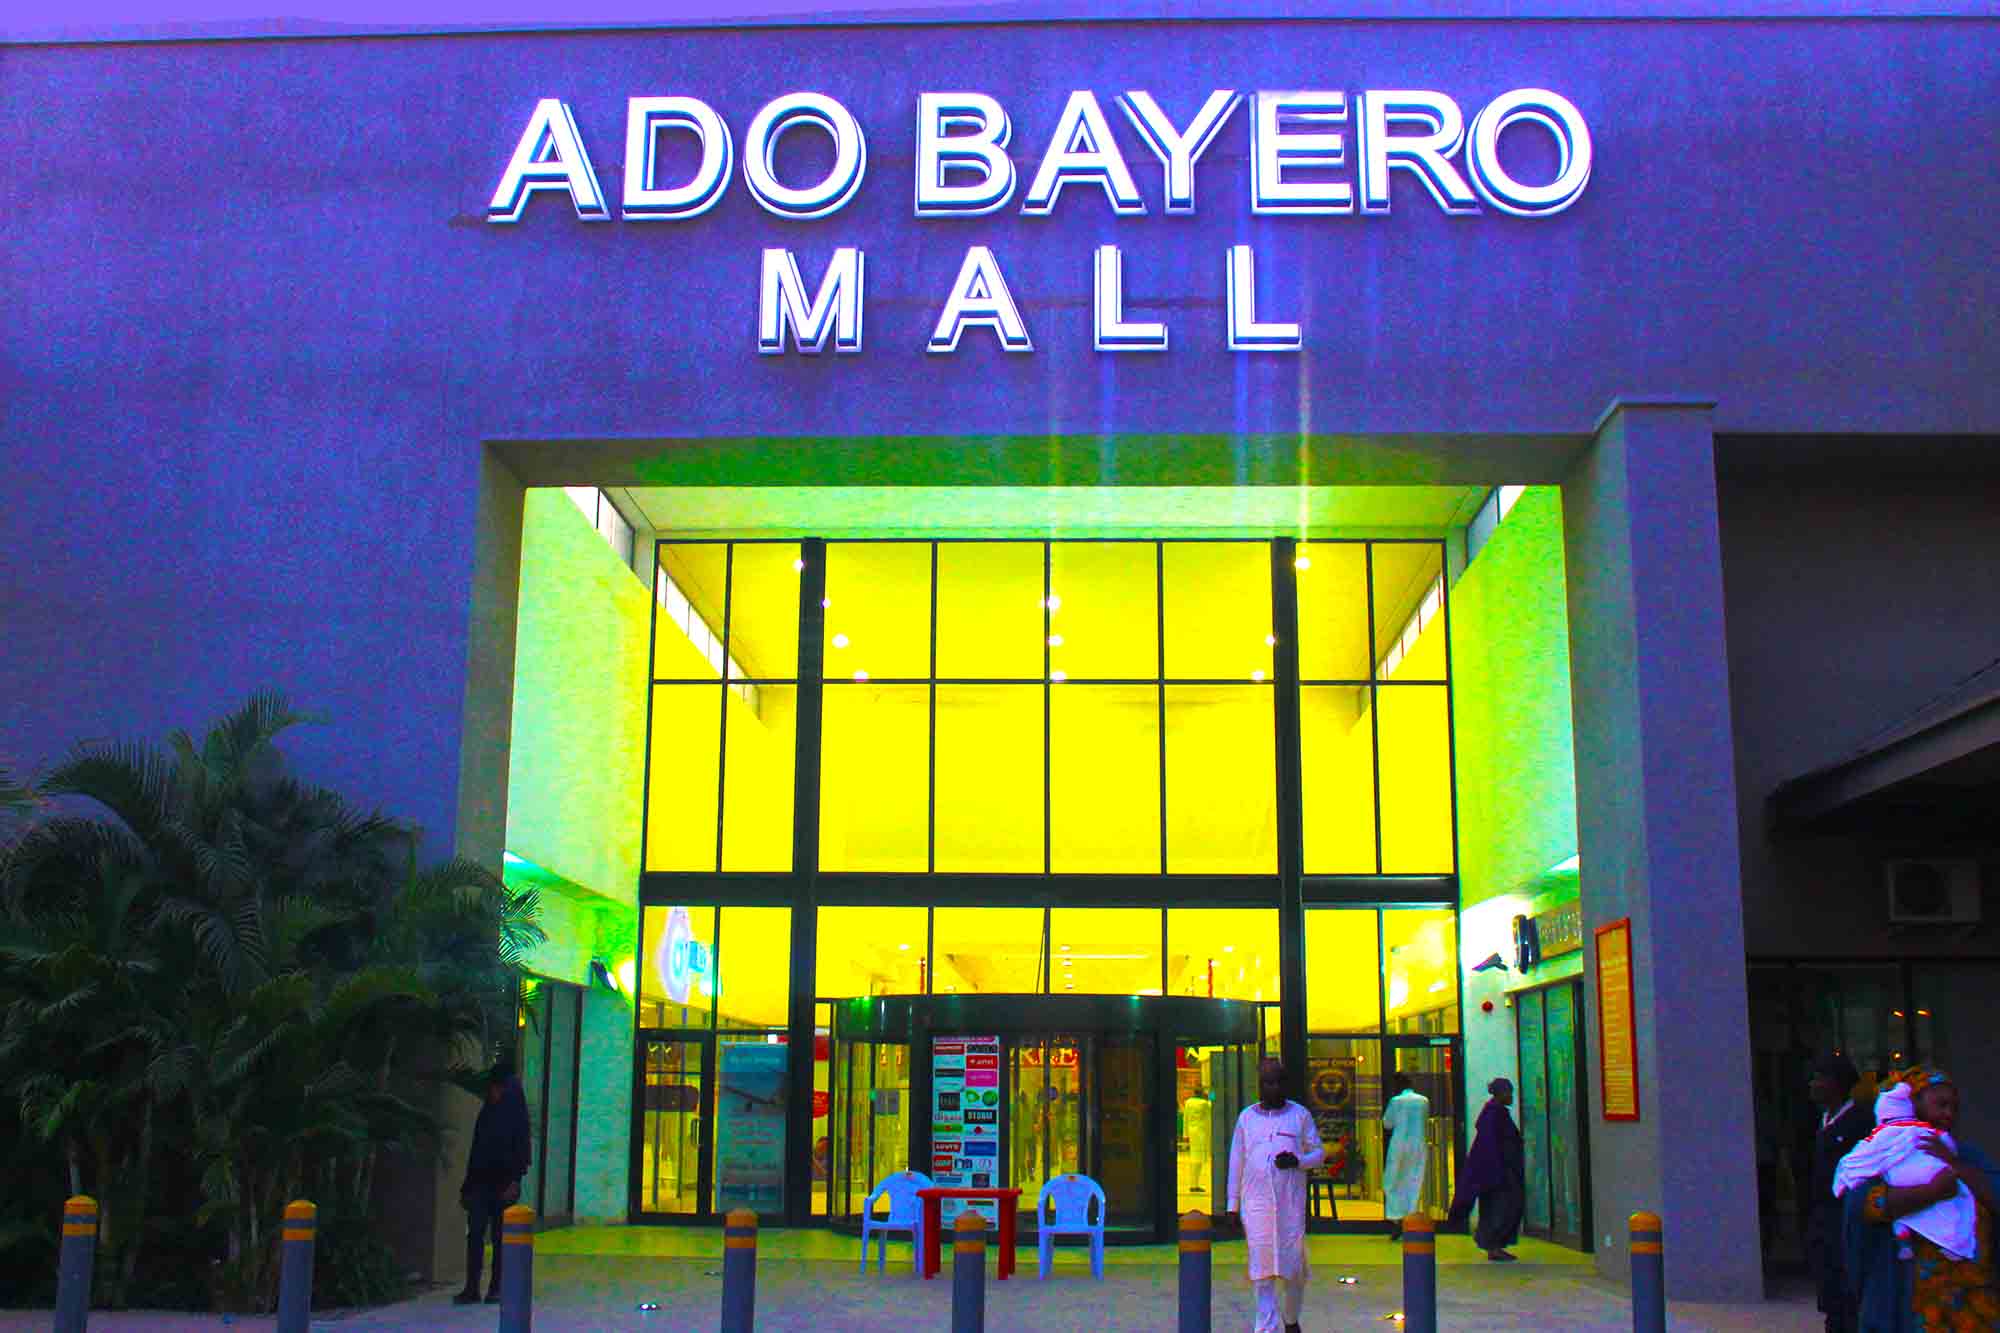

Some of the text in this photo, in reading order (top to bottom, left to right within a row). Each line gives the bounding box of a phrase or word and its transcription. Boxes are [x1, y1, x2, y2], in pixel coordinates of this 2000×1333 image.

[487, 87, 1592, 222] ADO BAYERO
[757, 245, 1303, 353] MALL
